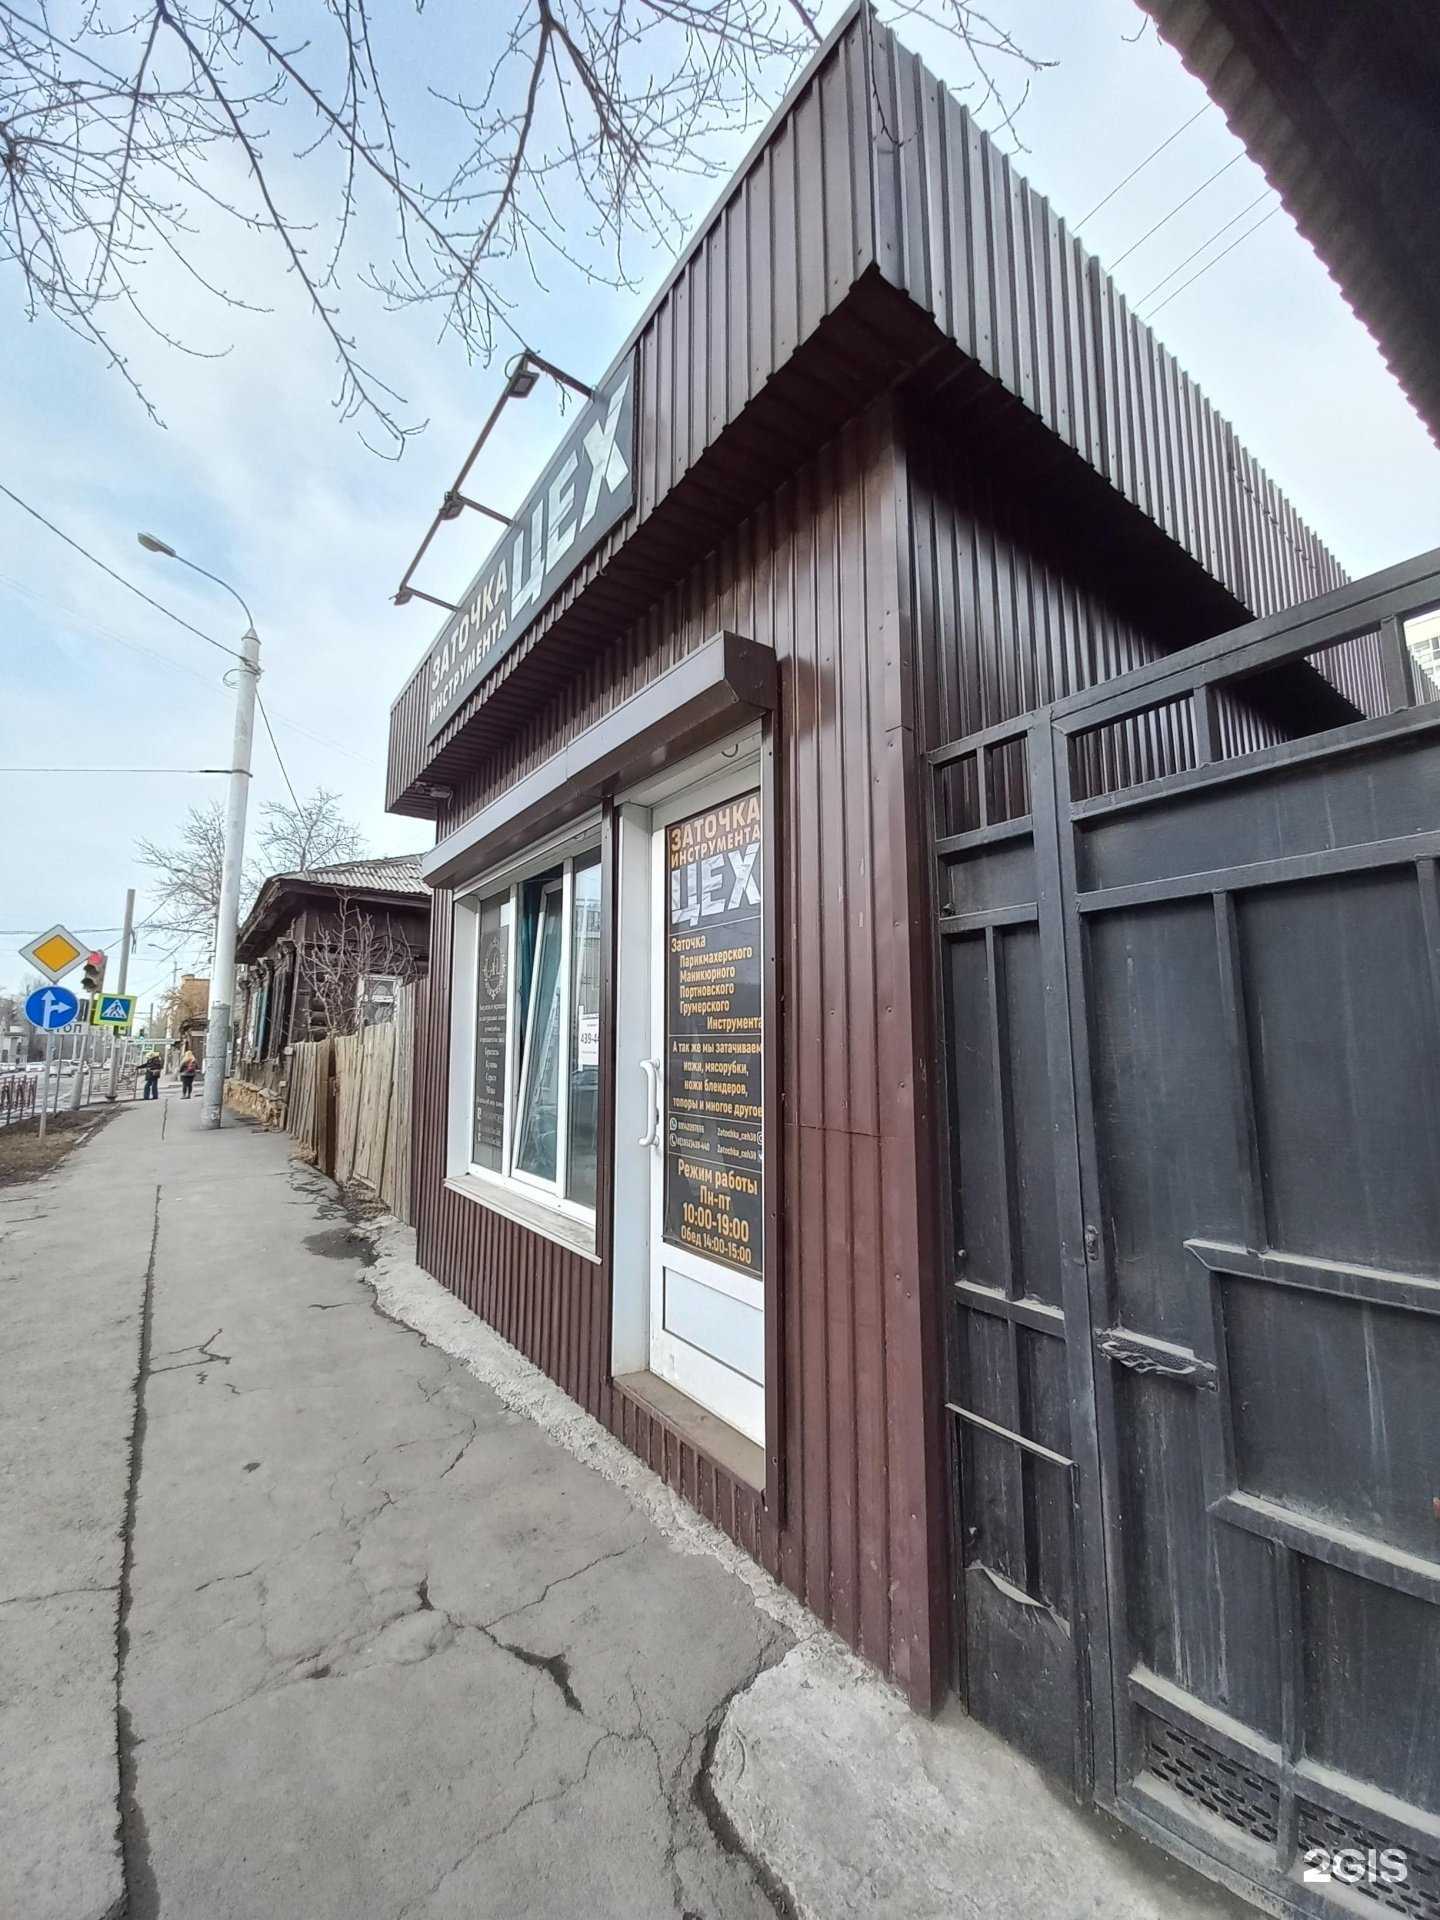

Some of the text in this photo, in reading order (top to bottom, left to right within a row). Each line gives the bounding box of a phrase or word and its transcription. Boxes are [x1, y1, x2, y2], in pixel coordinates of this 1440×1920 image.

[510, 373, 630, 622] ЦЕХ
[431, 559, 508, 690] ЗАТОЧКА
[429, 609, 507, 724] ИНСТРУМЕНТА
[671, 796, 761, 852] ЗАТОЧКА
[671, 824, 761, 868] ИНСТРУМЕНТА
[671, 842, 761, 927] ЦЕХ
[671, 935, 706, 952] Заточка
[679, 946, 753, 970] Парикмахерского
[680, 966, 736, 983] Маникюрного
[680, 983, 735, 1000] Портновского
[680, 1000, 730, 1017] Грумерского
[678, 1043, 690, 1053] так
[691, 1043, 701, 1054] же
[703, 1043, 715, 1054] мы
[683, 1060, 749, 1077] ножи, мясорубки,
[684, 1078, 748, 1098] ножи блендеров,
[672, 1097, 698, 1112] топоры
[699, 1100, 704, 1110] и
[705, 1101, 732, 1114] многое
[678, 1158, 759, 1196] Режим работы
[699, 1185, 731, 1212] Пн-пт
[682, 1201, 749, 1243] 10:00-19:00
[680, 1224, 752, 1265] Обед 14:00-15:00
